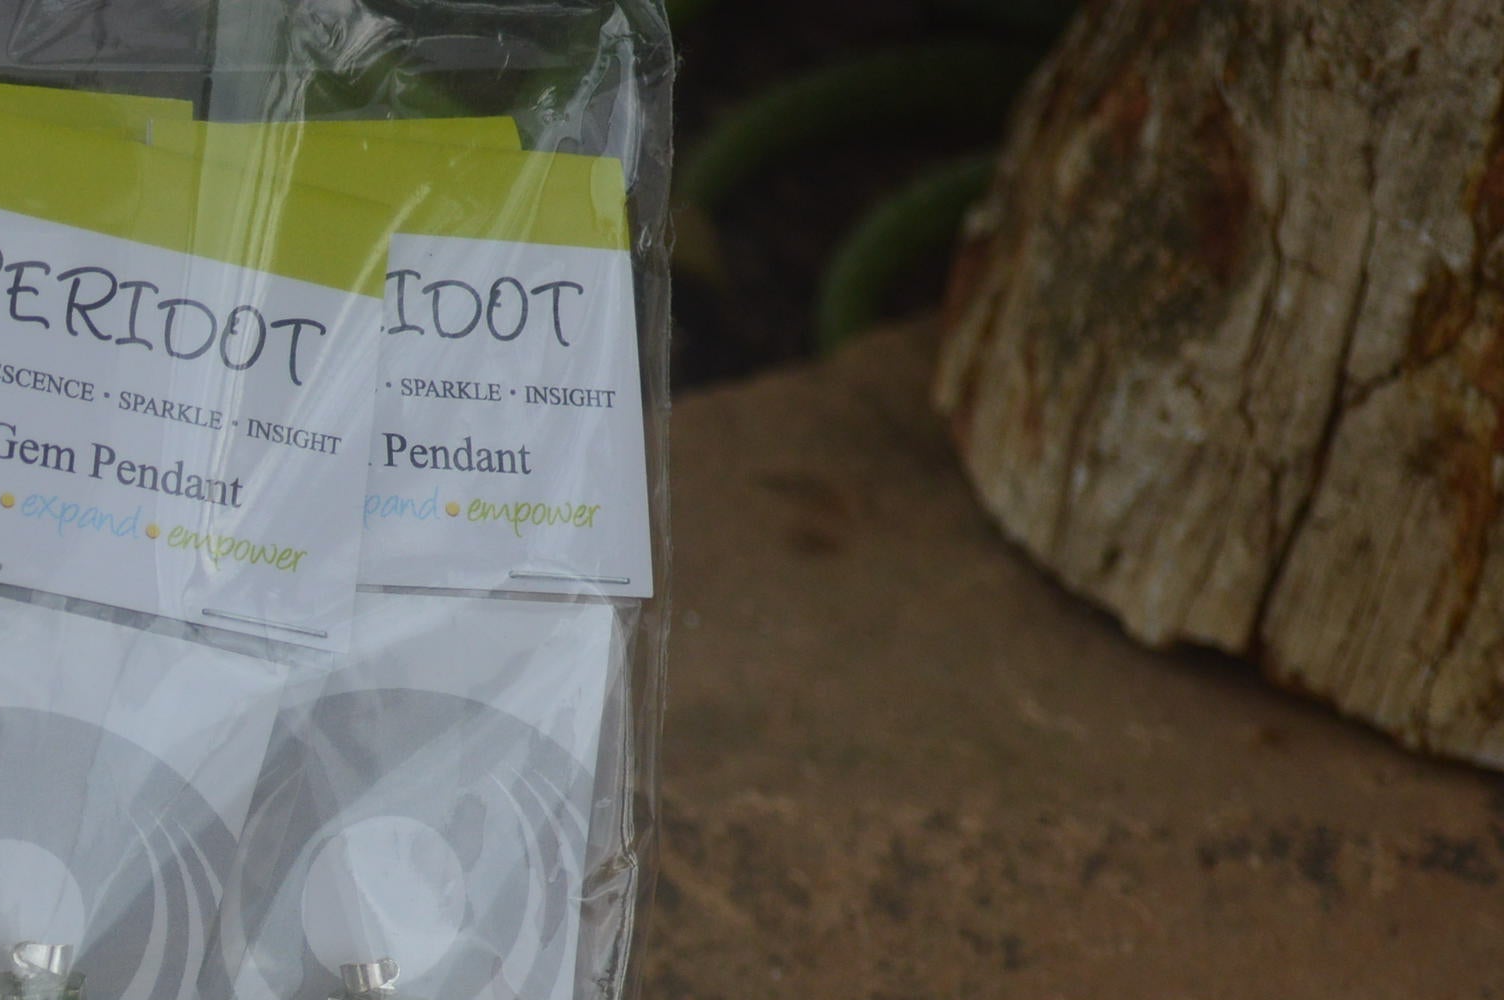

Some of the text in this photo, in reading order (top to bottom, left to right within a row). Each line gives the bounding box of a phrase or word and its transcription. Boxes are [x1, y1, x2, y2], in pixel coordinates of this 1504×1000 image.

[380, 269, 584, 347] IDOT
[118, 390, 223, 430] SPARKLE
[246, 418, 342, 455] INSIGHT
[400, 378, 616, 408] SPARKLE INSIGHT
[88, 443, 243, 508] Pendant
[382, 433, 532, 475] Pendant
[20, 493, 140, 540] expand
[167, 521, 308, 573] empower
[467, 498, 600, 537] empower
